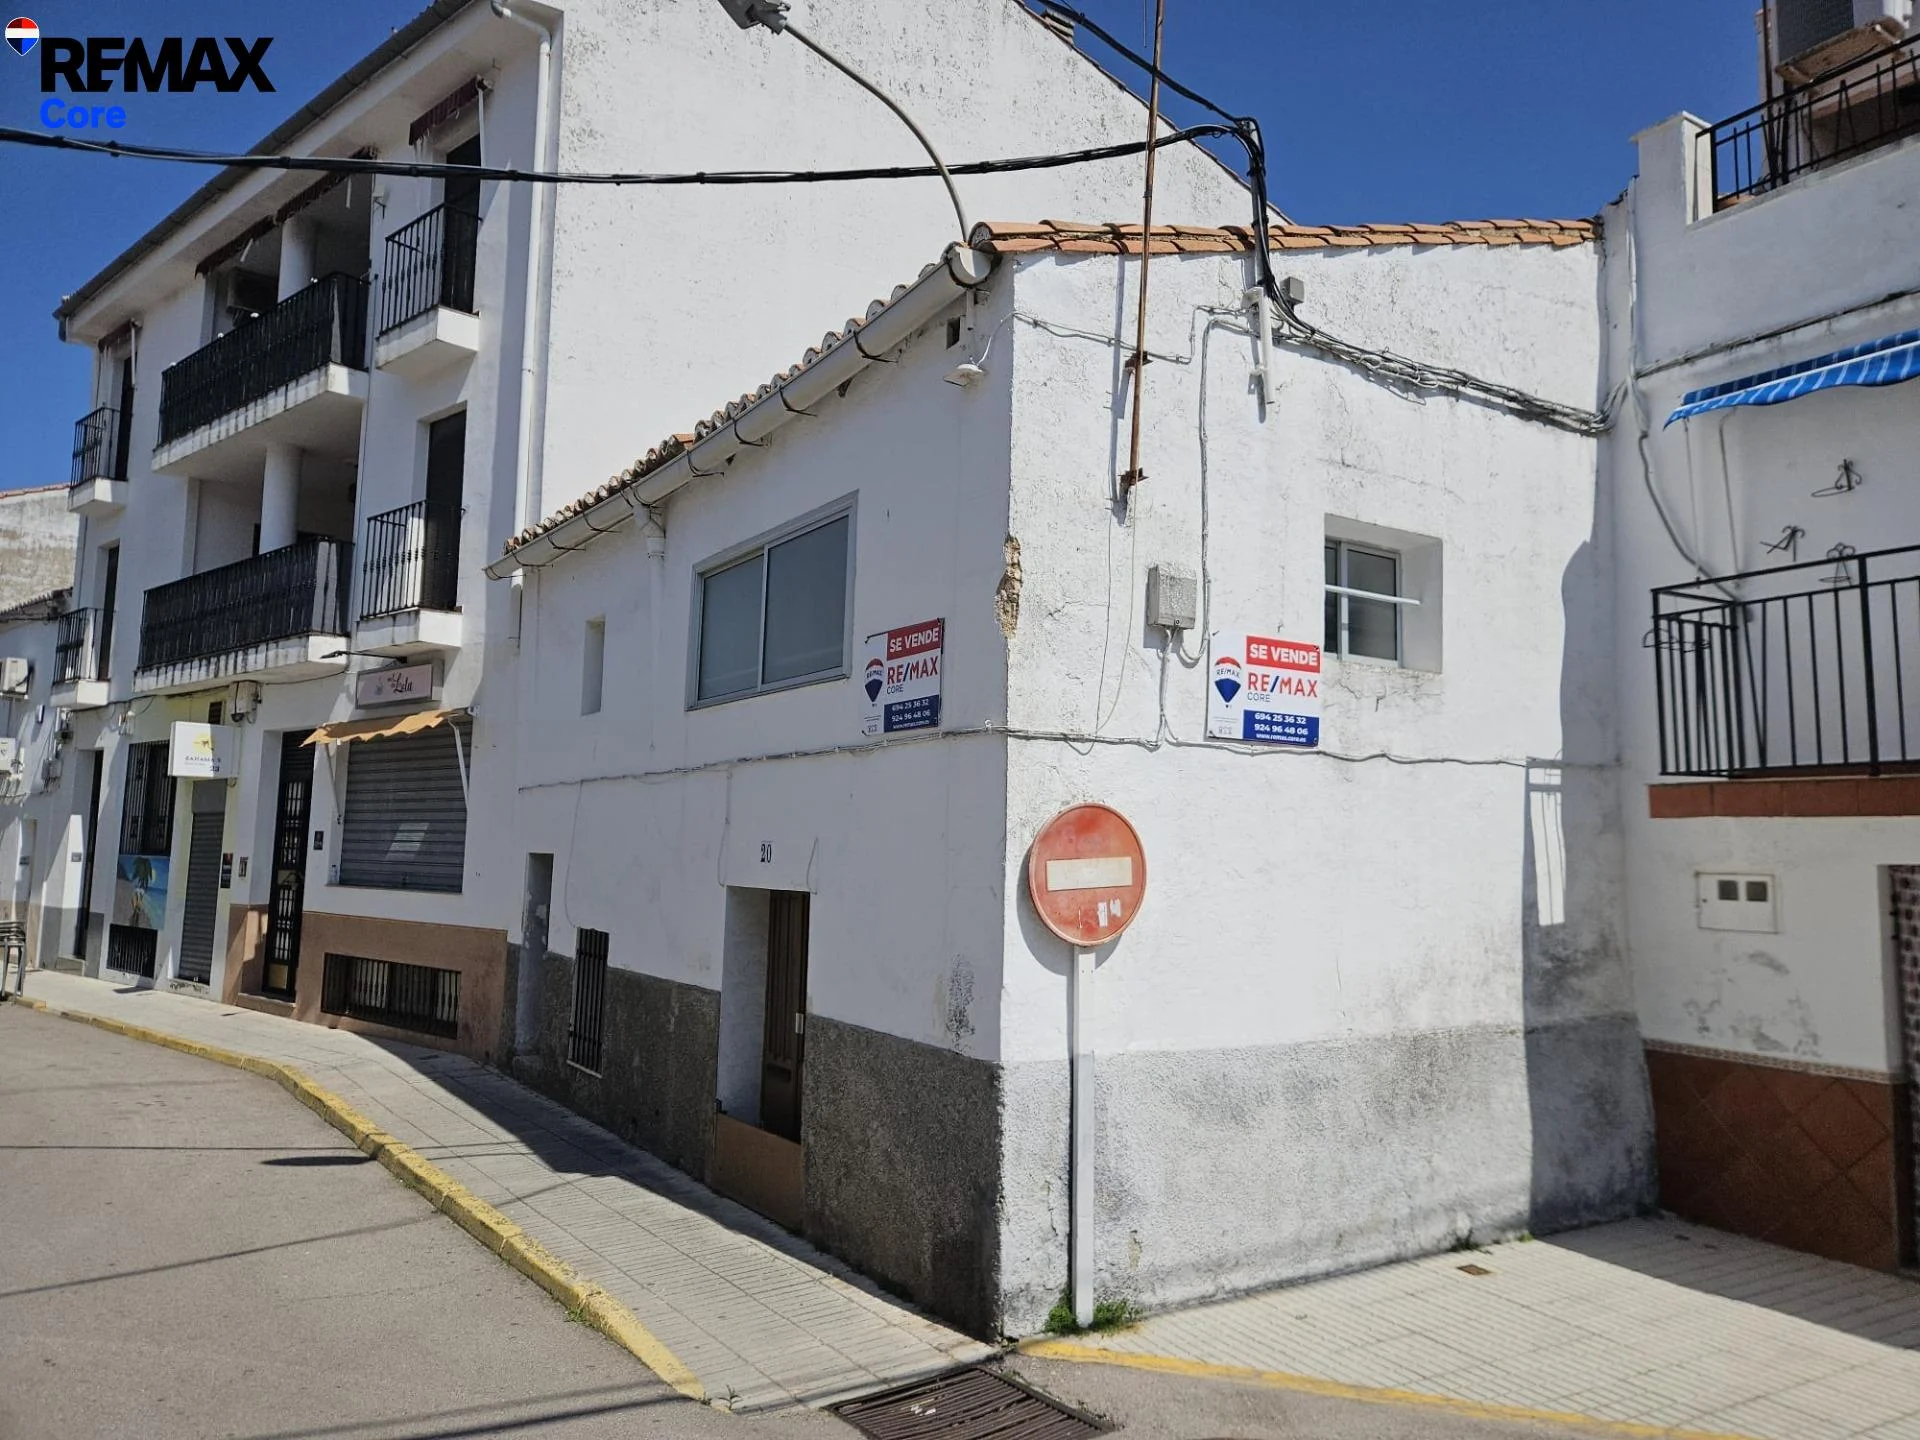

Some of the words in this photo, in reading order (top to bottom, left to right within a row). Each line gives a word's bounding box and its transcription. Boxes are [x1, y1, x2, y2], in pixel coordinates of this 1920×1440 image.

[889, 639, 902, 653] SE
[905, 627, 939, 648] VENDE
[1249, 643, 1268, 659] SE
[1270, 646, 1318, 666] VENDE
[887, 655, 938, 685] RE/MAX
[1216, 668, 1240, 679] RE/MAX
[886, 684, 904, 695] CORE
[1247, 672, 1318, 698] RE/MAX
[1247, 692, 1271, 702] CORE
[891, 713, 904, 722] 924
[904, 712, 912, 720] 96
[913, 710, 922, 718] 48
[1254, 712, 1271, 721] 694
[1272, 714, 1283, 722] 25
[1284, 715, 1295, 723] 36
[1296, 717, 1306, 725] 32
[1254, 723, 1271, 731] 924
[1272, 725, 1283, 733] 96
[1284, 726, 1296, 735] 48
[1297, 727, 1309, 736] 06
[760, 843, 772, 864] 20
